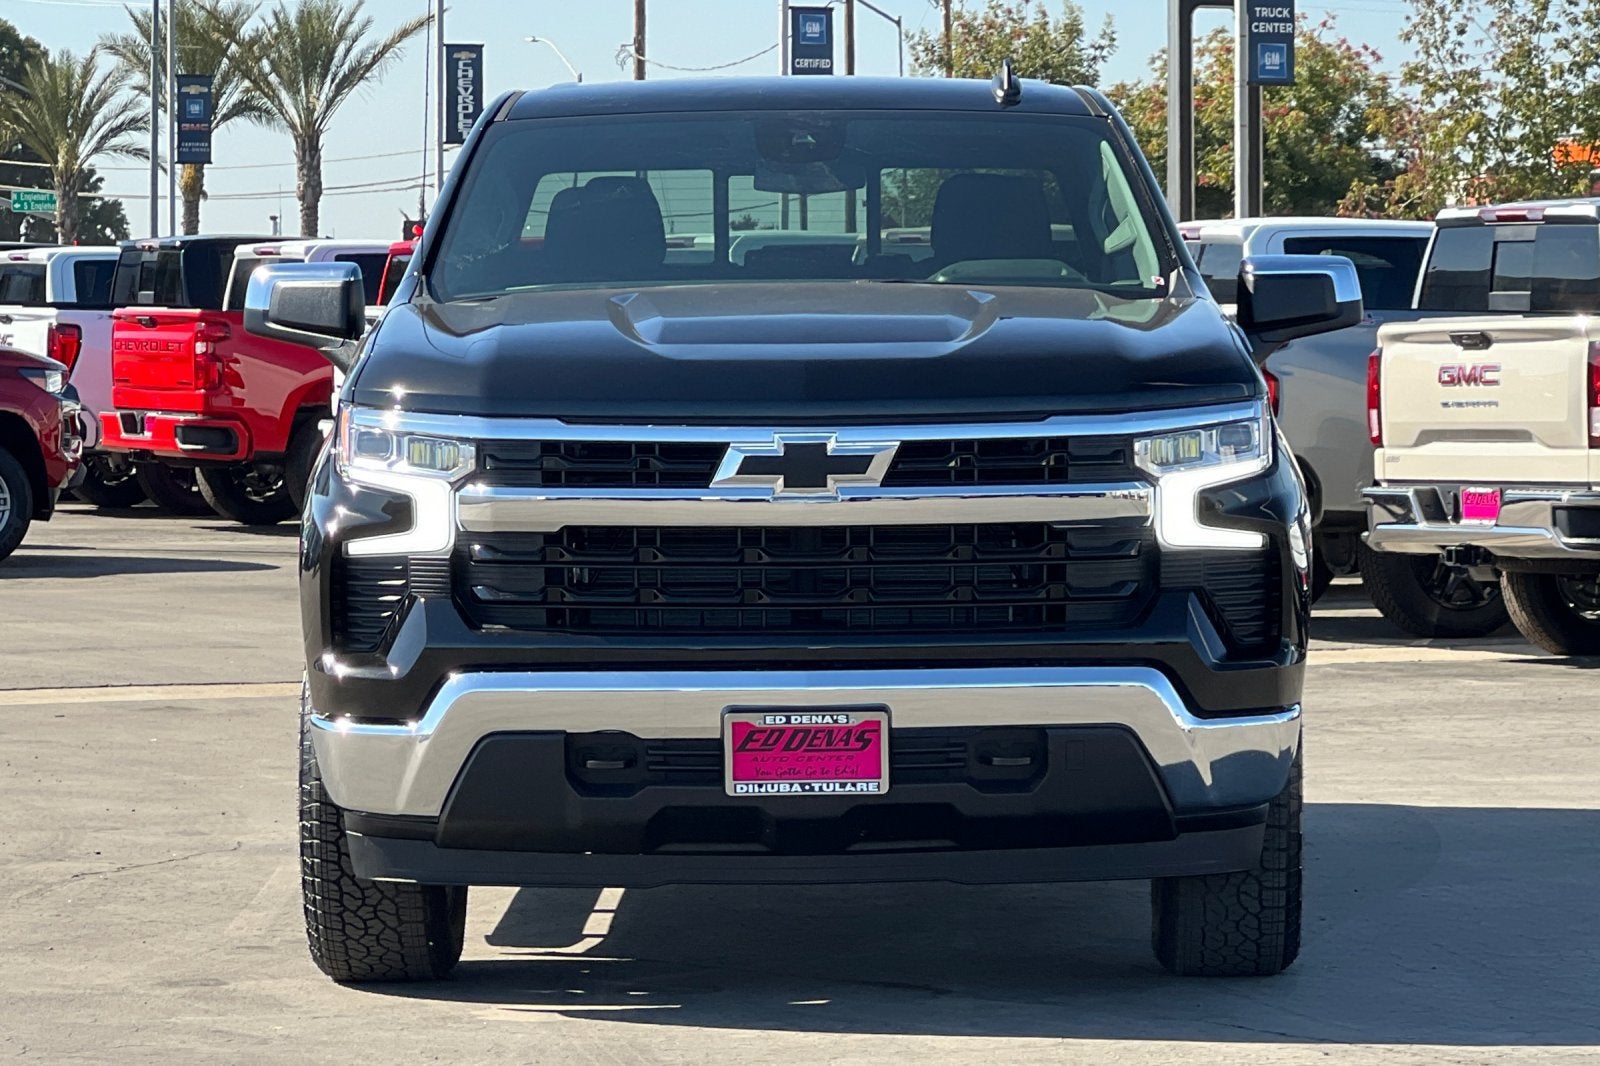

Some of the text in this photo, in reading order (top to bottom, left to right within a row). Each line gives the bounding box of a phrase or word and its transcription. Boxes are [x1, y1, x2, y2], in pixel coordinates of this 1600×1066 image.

[1254, 7, 1290, 18] TRUCK
[805, 22, 820, 34] GM
[1251, 22, 1293, 33] CENTER
[794, 58, 832, 69] CERTIFIED
[1265, 51, 1280, 66] GM
[457, 60, 474, 139] CHEVROLET
[181, 123, 209, 131] GMC
[23, 202, 28, 210] S
[115, 341, 184, 353] CHEVROLET
[1438, 364, 1501, 387] GMC
[765, 715, 848, 725] ED DENA'S
[737, 728, 782, 753] ED
[796, 754, 855, 762] CENTER
[805, 766, 818, 776] Go
[811, 782, 879, 792] TULARE
